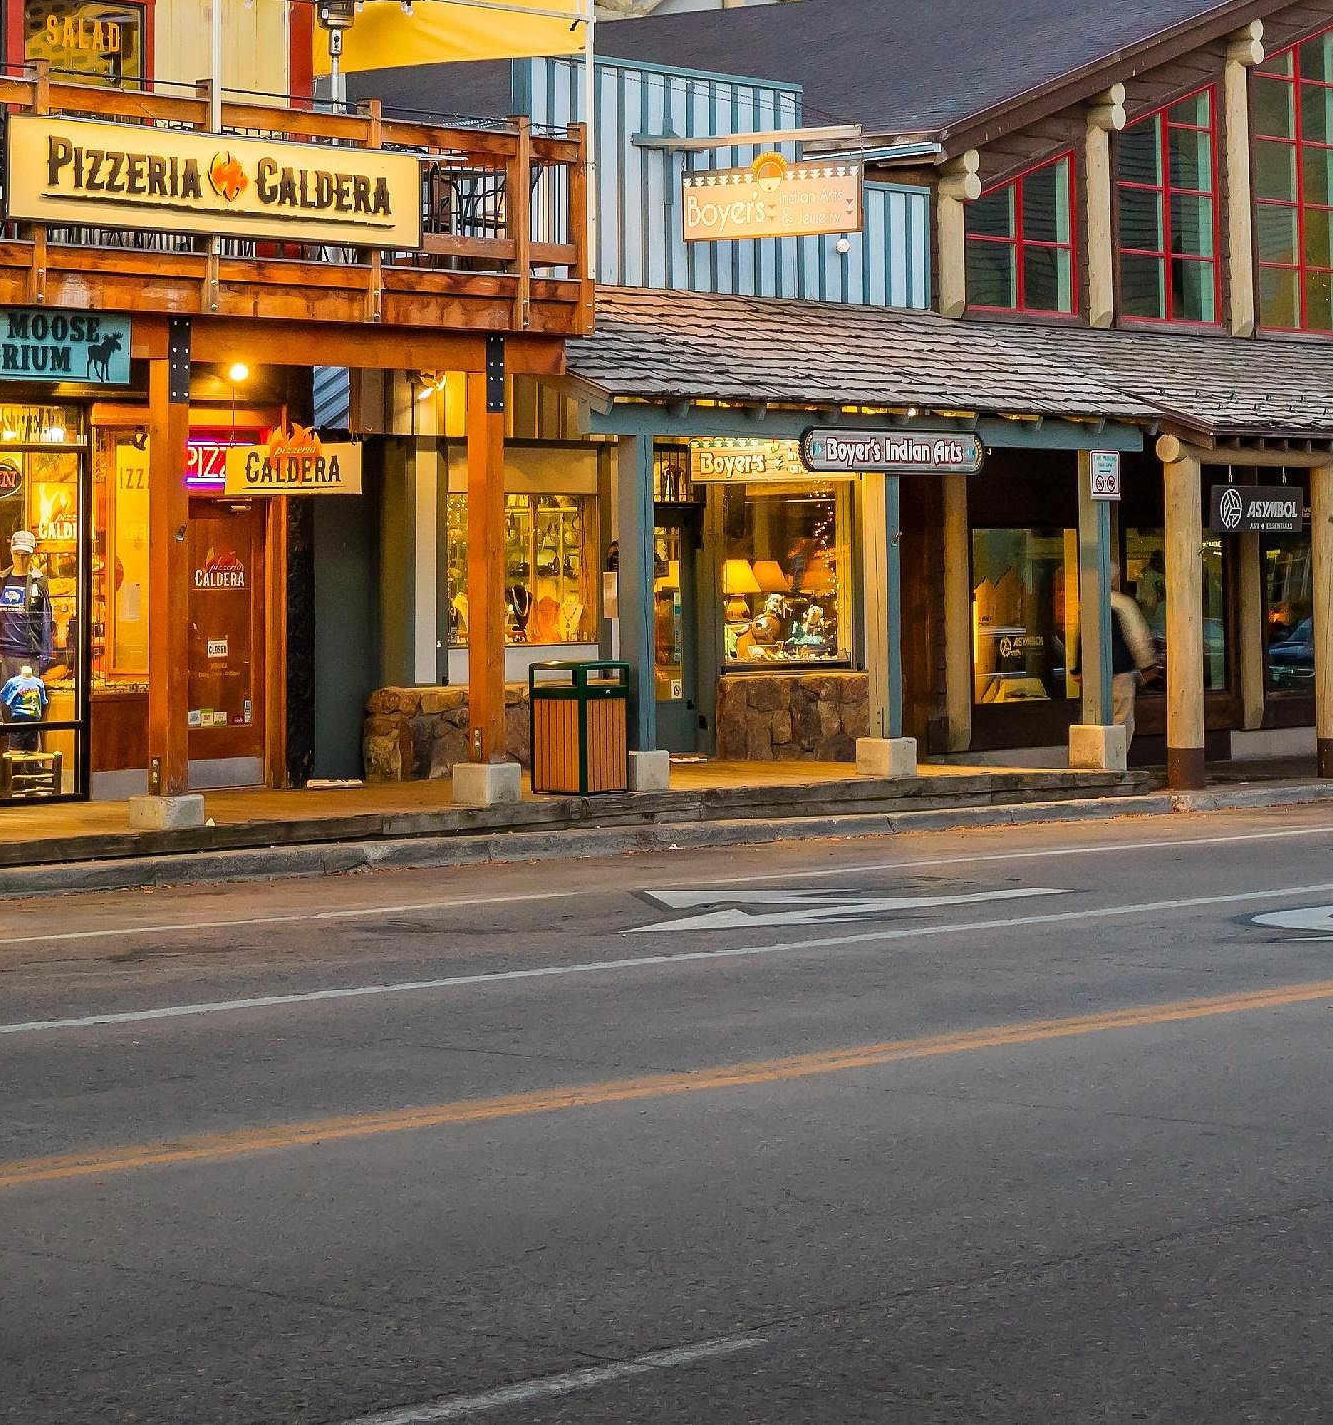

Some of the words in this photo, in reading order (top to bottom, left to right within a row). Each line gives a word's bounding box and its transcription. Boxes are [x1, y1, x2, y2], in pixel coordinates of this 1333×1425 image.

[46, 13, 121, 53] SALAD
[47, 134, 203, 200] PIZZERIA
[256, 156, 392, 216] CALDERA
[688, 190, 765, 232] Boyer's
[7, 312, 100, 343] MOOSE
[274, 446, 317, 457] pizzeria
[700, 452, 767, 477] Boyer's
[826, 437, 881, 467] Boyer's
[885, 437, 931, 464] Indian
[933, 438, 964, 464] Arts
[245, 451, 342, 483] CALDERA
[1246, 501, 1298, 518] ASYMBOL
[194, 569, 245, 587] CALDERA
